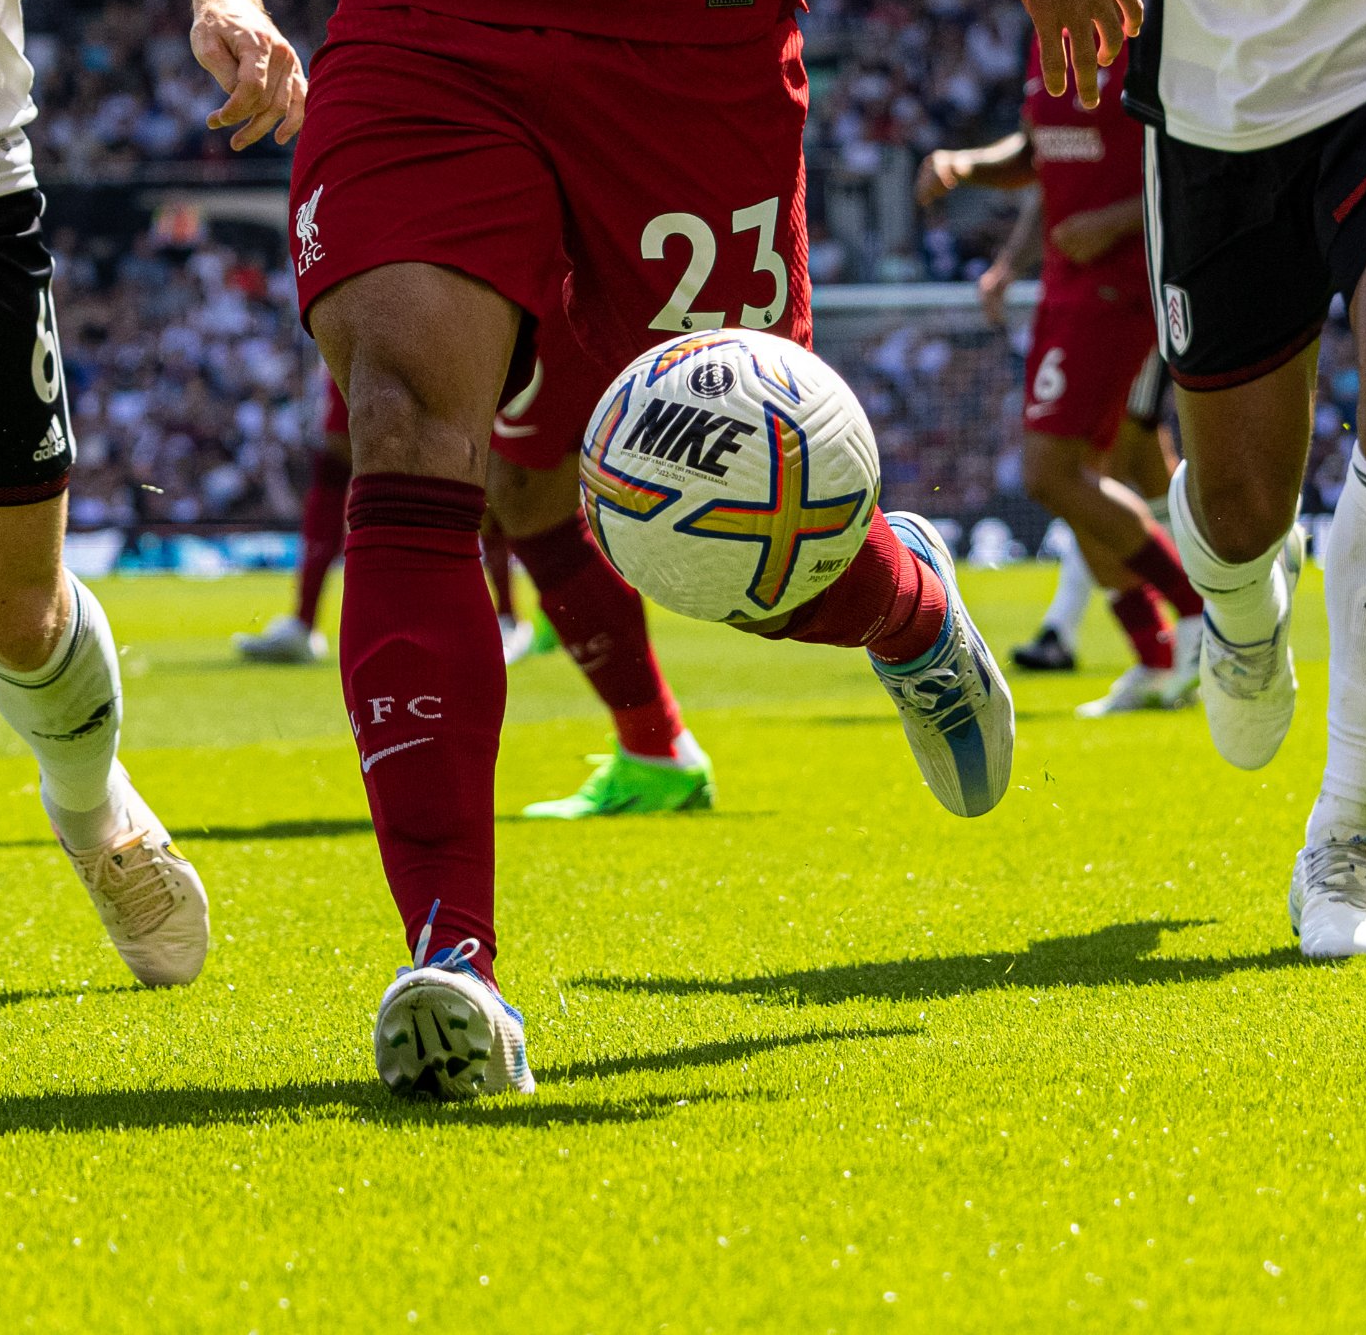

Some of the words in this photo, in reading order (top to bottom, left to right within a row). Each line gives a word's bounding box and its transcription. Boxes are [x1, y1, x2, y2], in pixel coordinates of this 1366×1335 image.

[640, 196, 789, 334] 23
[30, 288, 61, 404] 6
[1032, 345, 1067, 402] 6
[622, 397, 759, 478] NIKE
